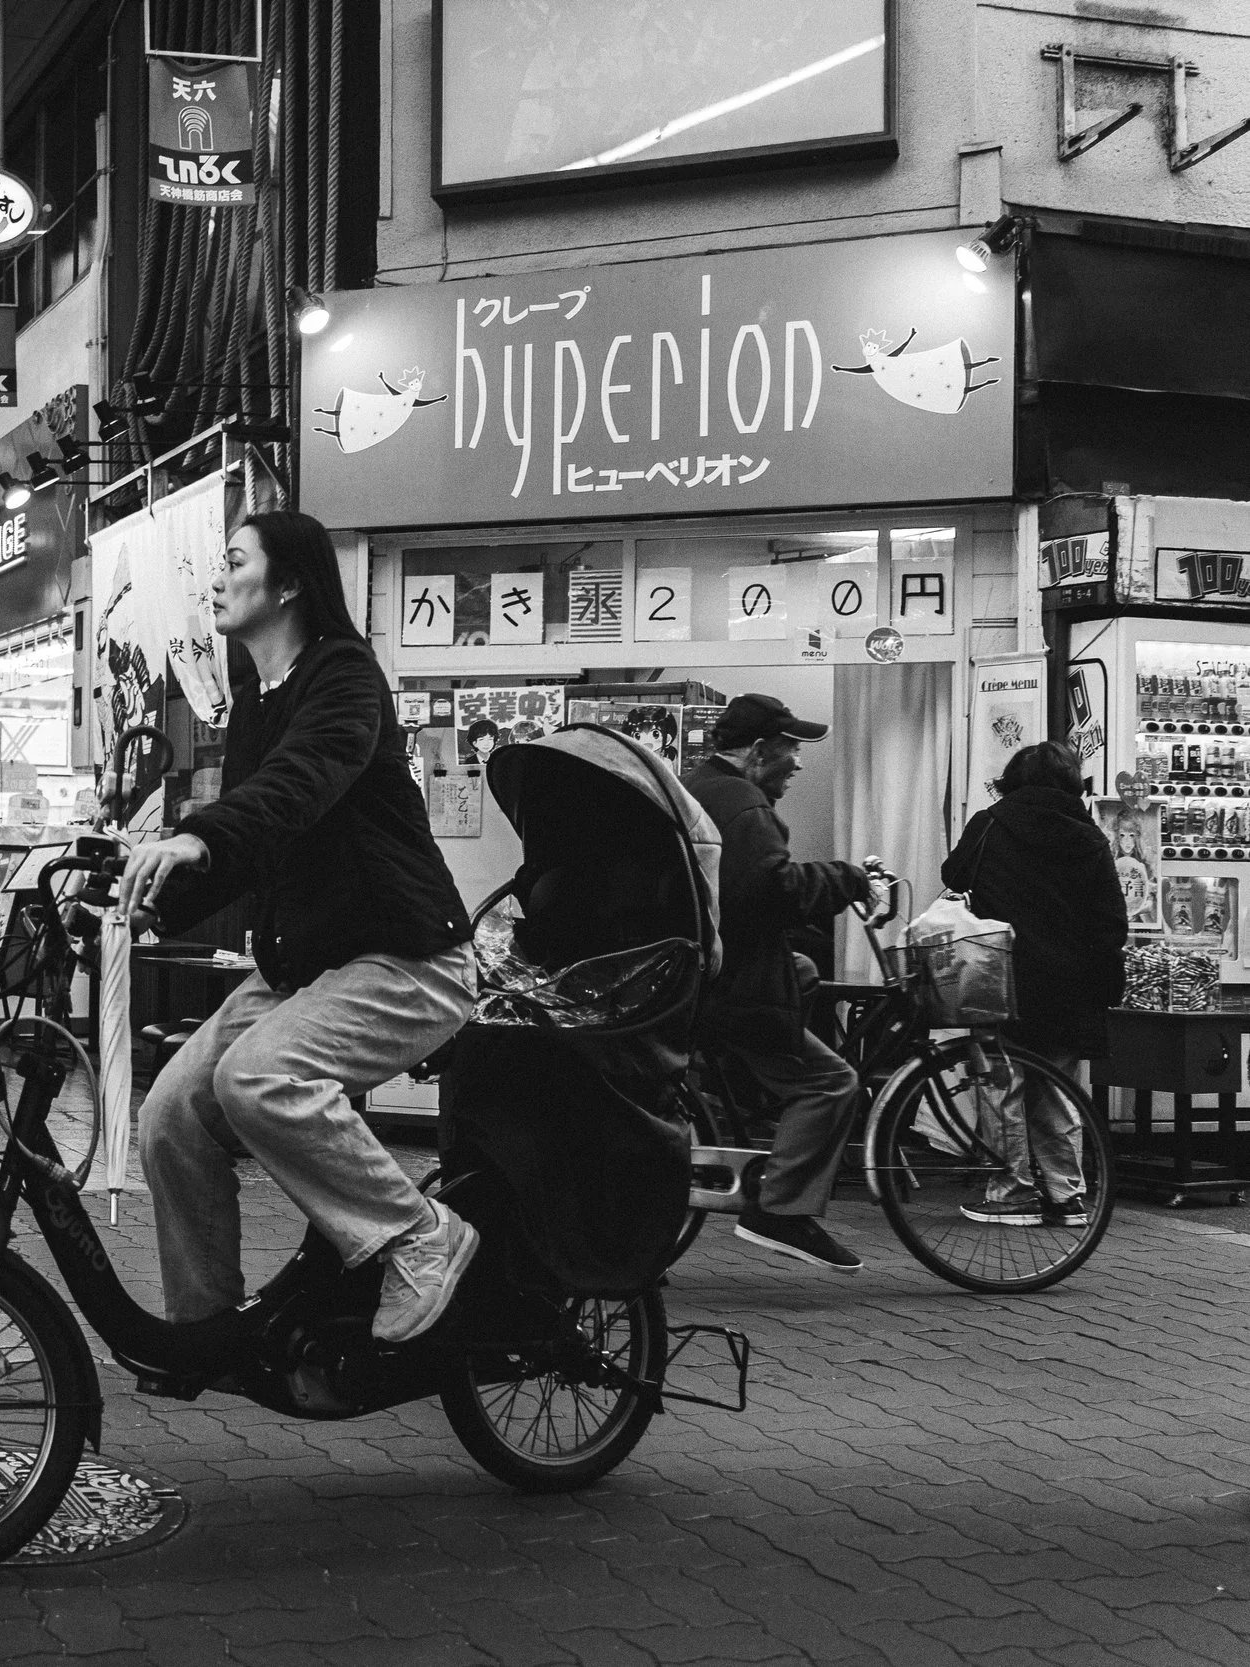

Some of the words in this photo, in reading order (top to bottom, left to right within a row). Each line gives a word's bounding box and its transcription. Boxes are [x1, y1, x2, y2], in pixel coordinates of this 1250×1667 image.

[173, 77, 217, 101] 天六
[160, 184, 244, 202] 天神橋筋商店会
[473, 285, 592, 328] クレープ
[455, 275, 822, 498] hyperion
[1177, 552, 1243, 600] 100
[1011, 678, 1038, 690] Menu
[458, 691, 547, 726] 営業中
